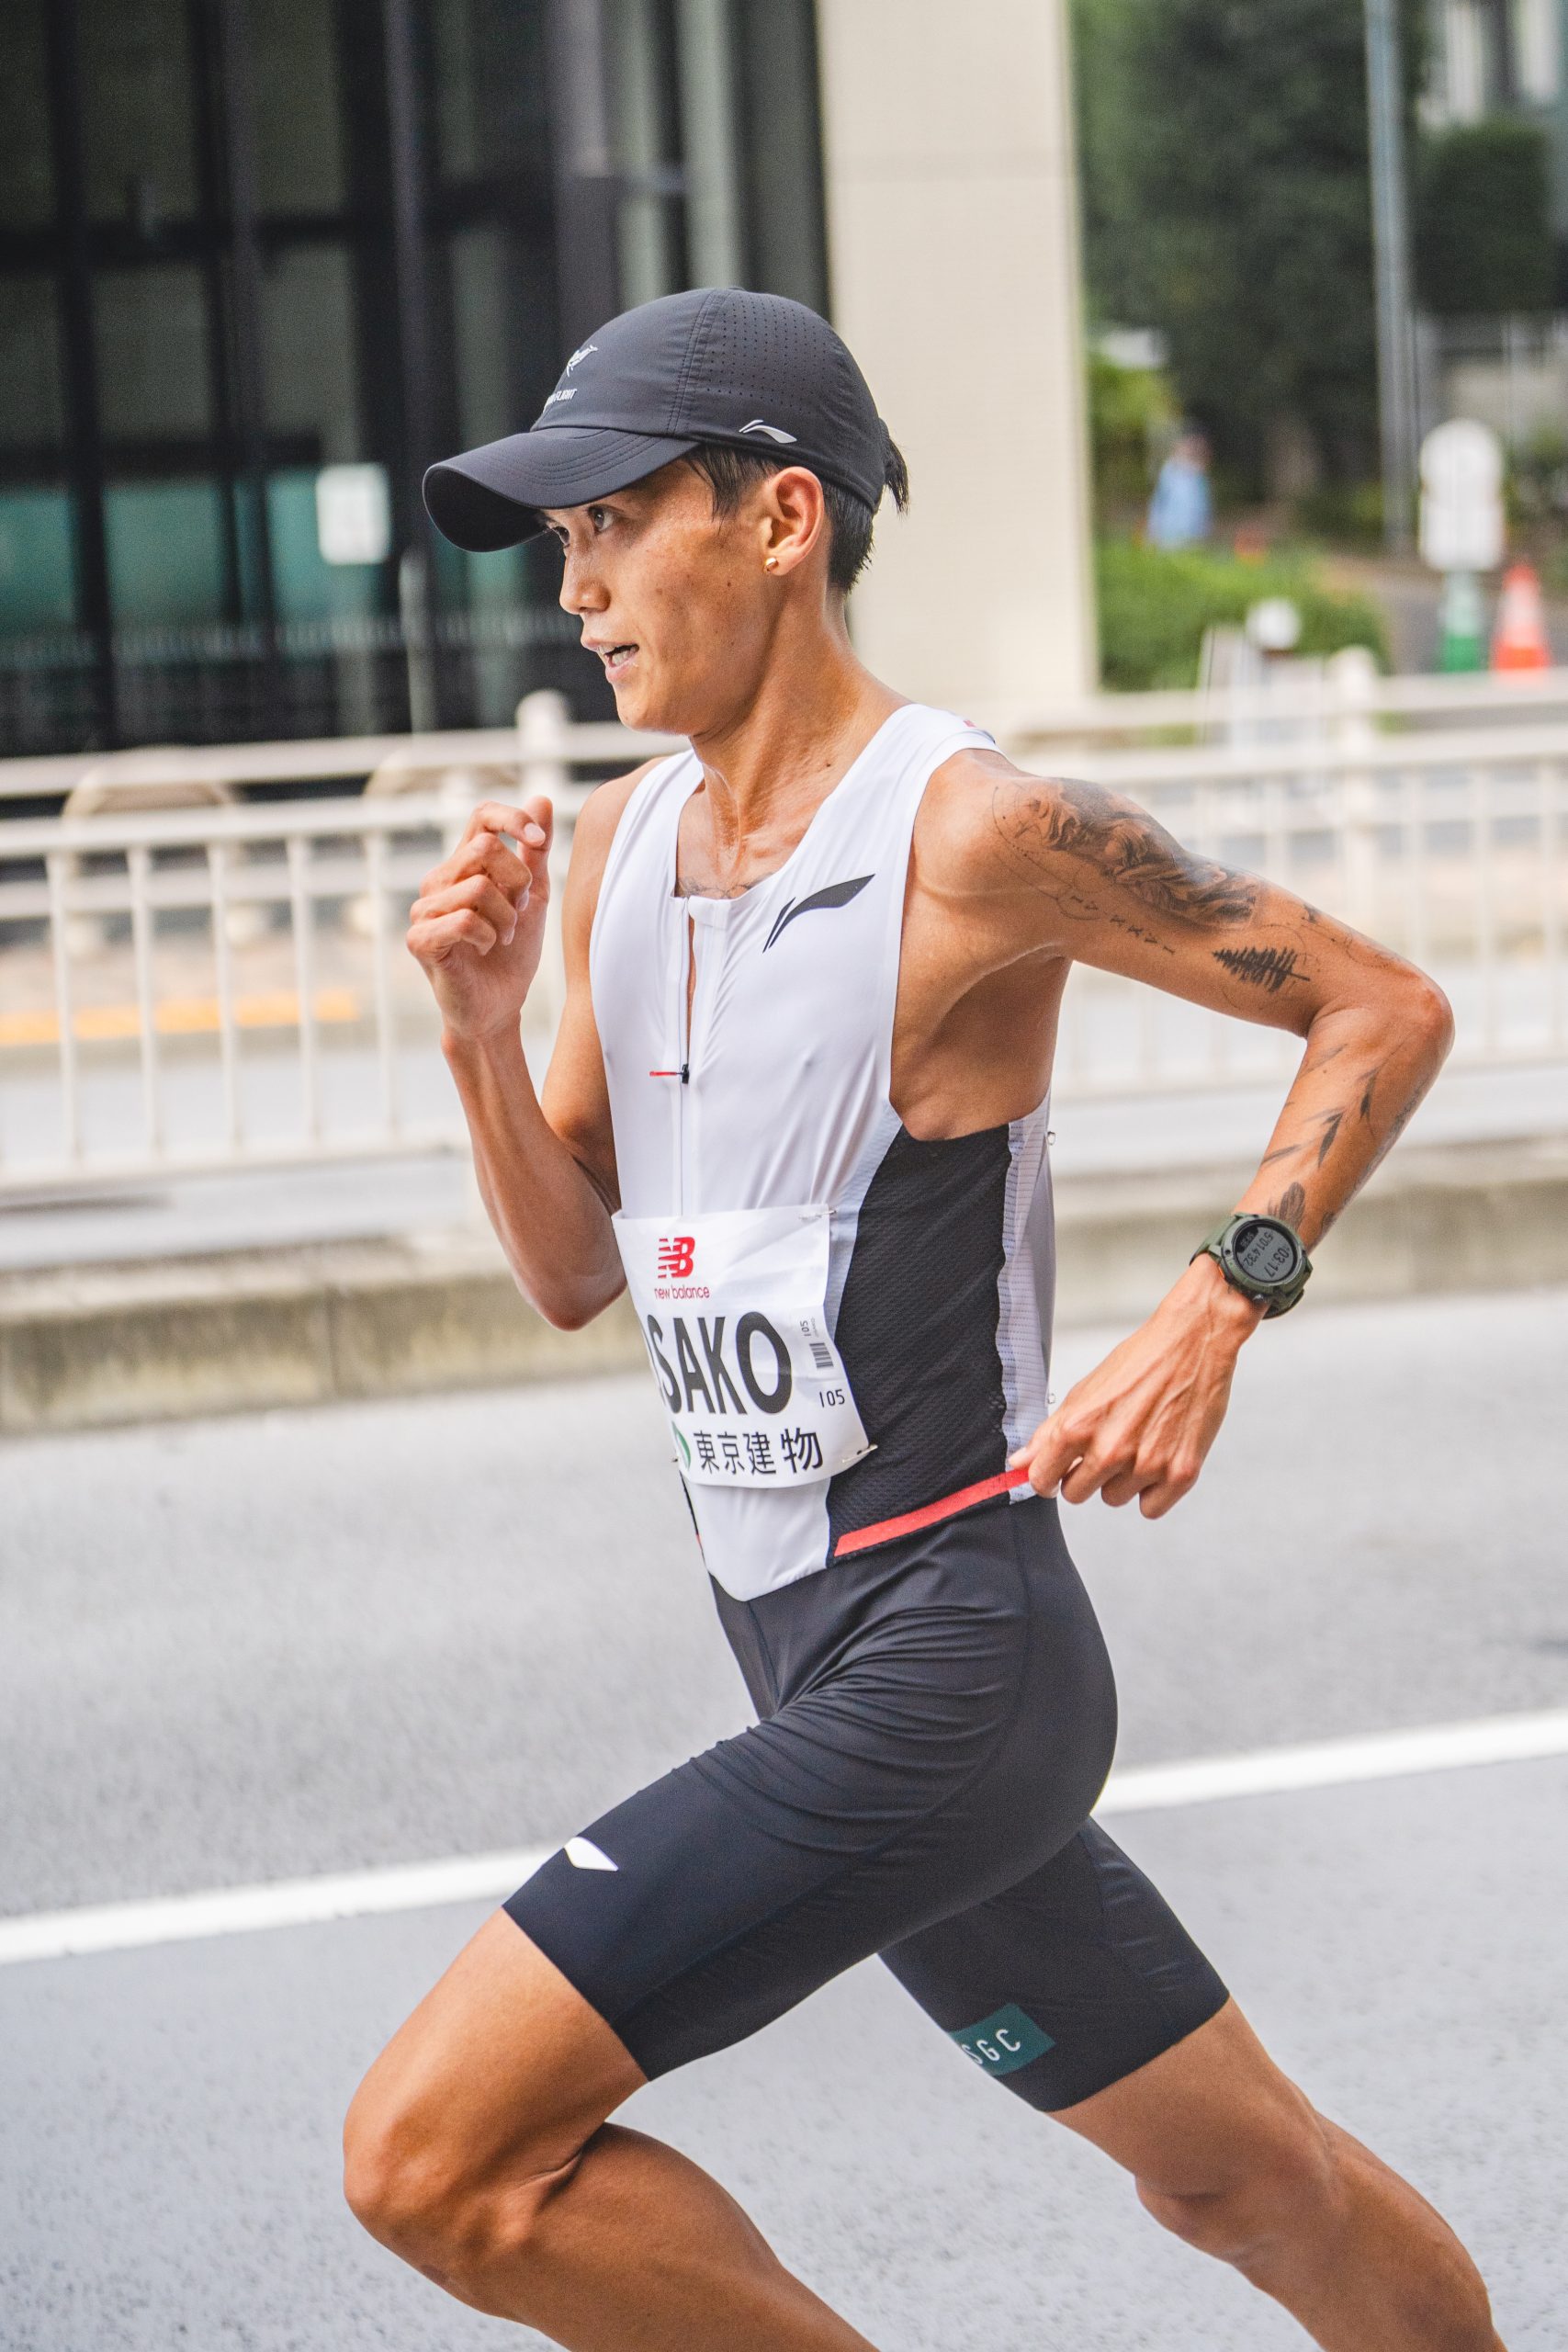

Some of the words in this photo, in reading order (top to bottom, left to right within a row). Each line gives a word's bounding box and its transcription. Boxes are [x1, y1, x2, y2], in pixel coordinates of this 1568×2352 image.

[654, 1287, 671, 1300] new
[671, 1284, 710, 1300] balance
[800, 1319, 812, 1337] 105
[641, 1312, 792, 1415] SAKO
[818, 1388, 845, 1408] 105
[693, 1427, 824, 1476] 東京建物
